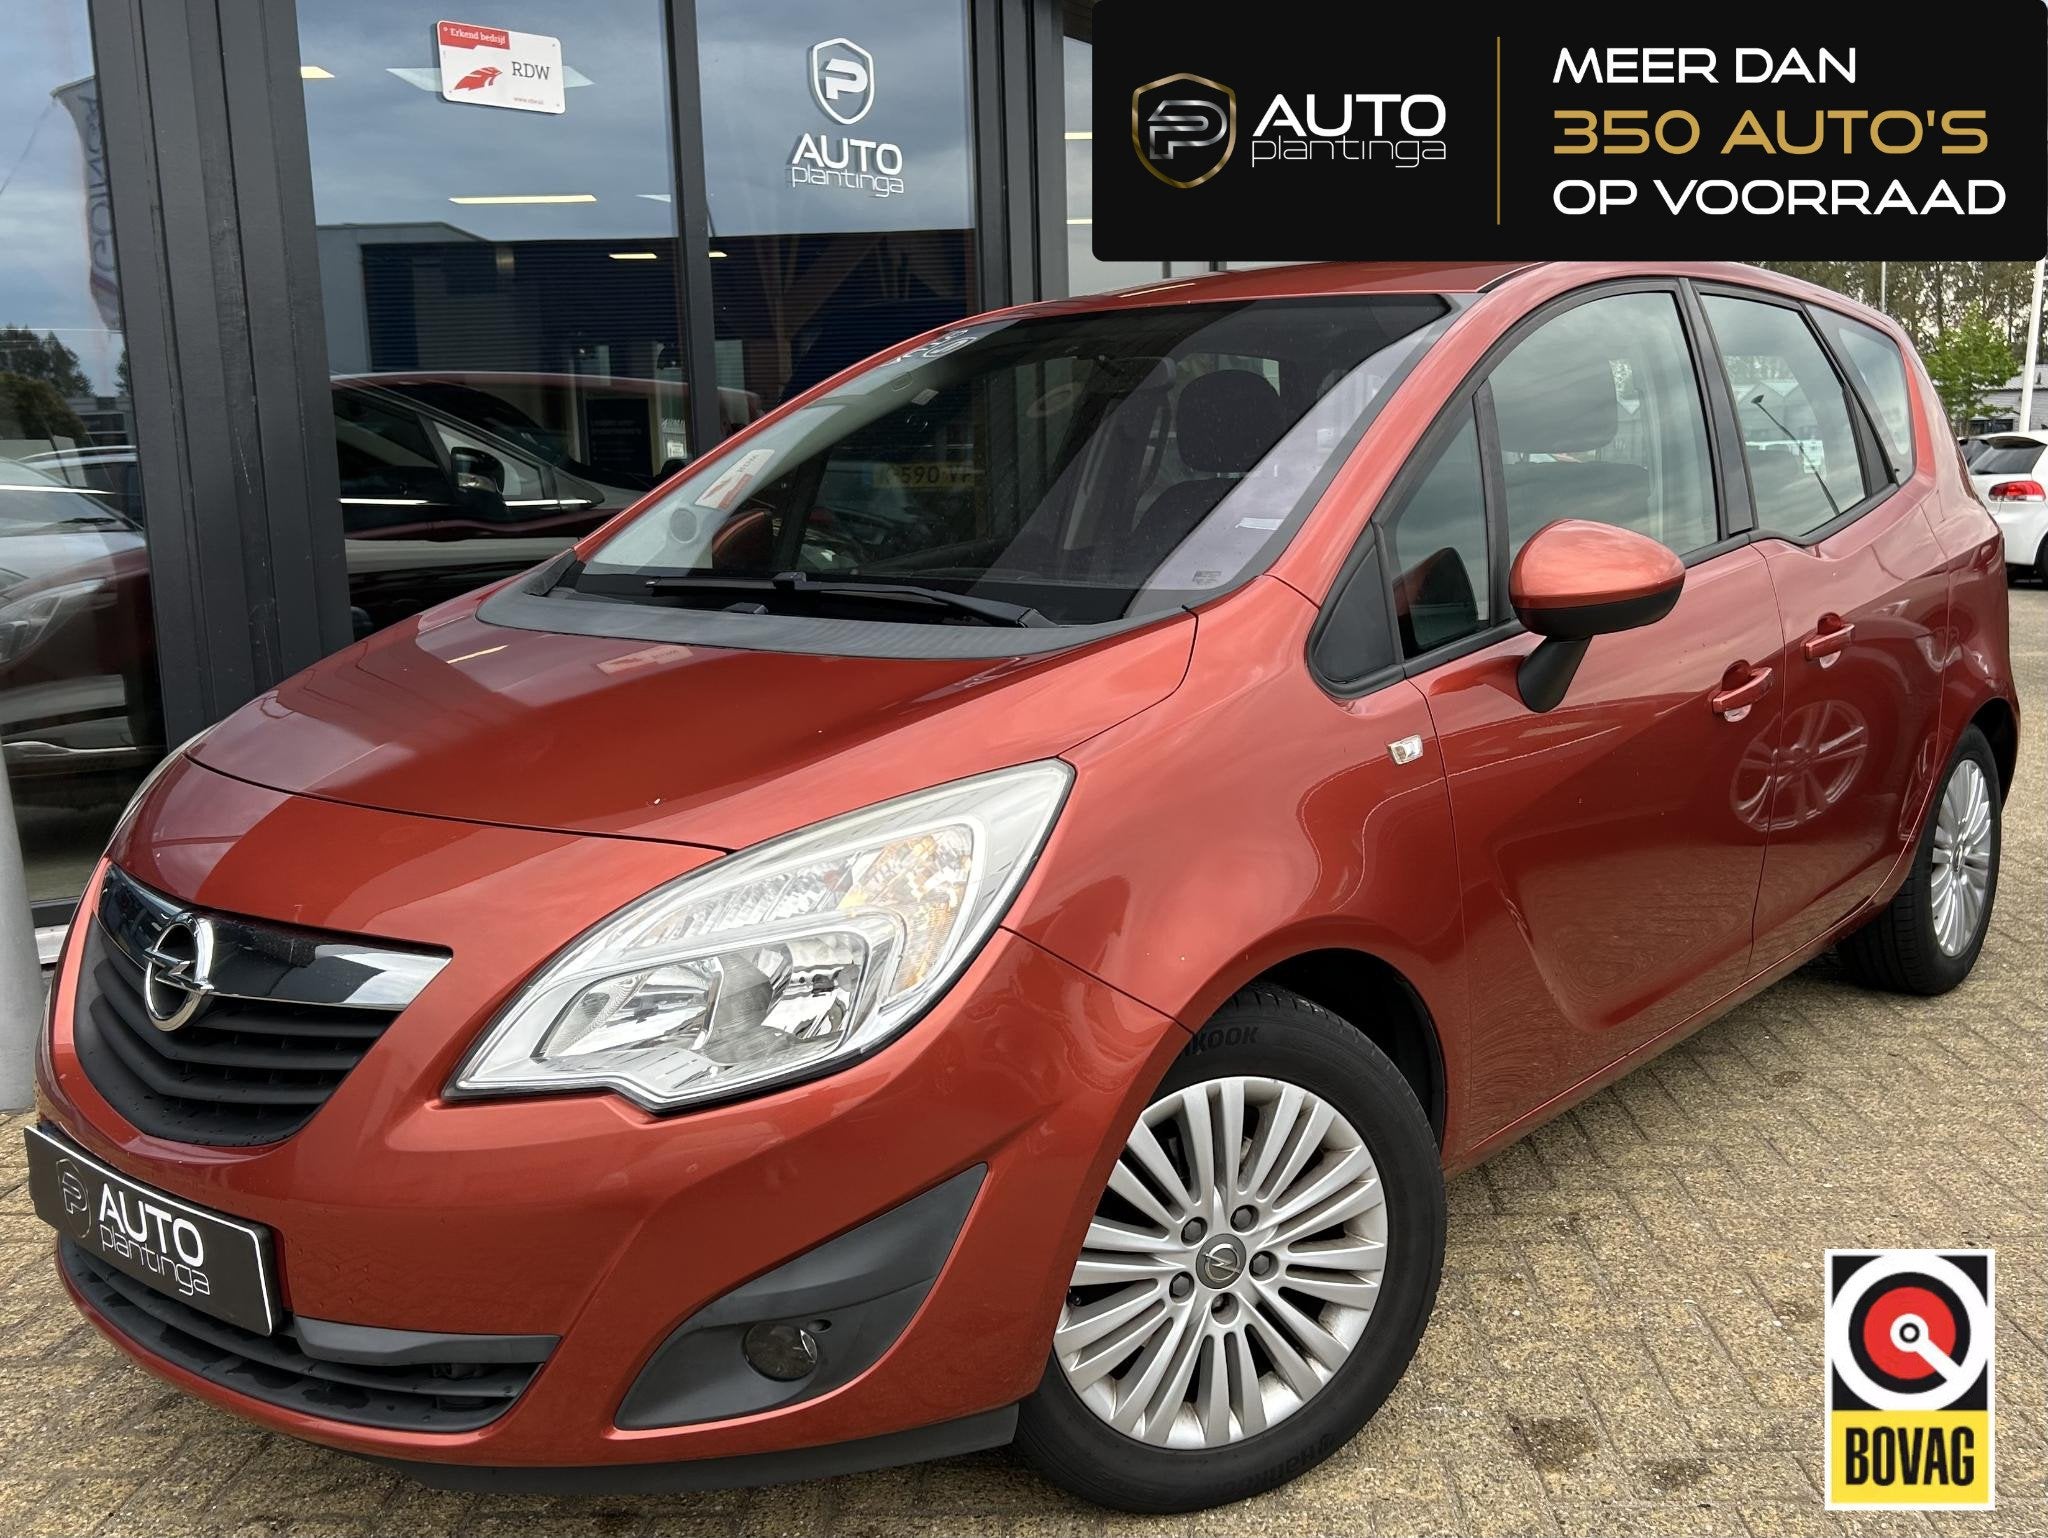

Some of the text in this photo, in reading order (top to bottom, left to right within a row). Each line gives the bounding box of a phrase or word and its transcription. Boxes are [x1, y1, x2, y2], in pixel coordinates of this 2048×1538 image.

[449, 27, 506, 45] Erkend bedrijf
[511, 61, 550, 80] RDW
[791, 133, 903, 175] AUTO
[791, 164, 904, 197] plantinga
[99, 1183, 204, 1267] AUTO
[100, 1223, 211, 1296] plantinga
